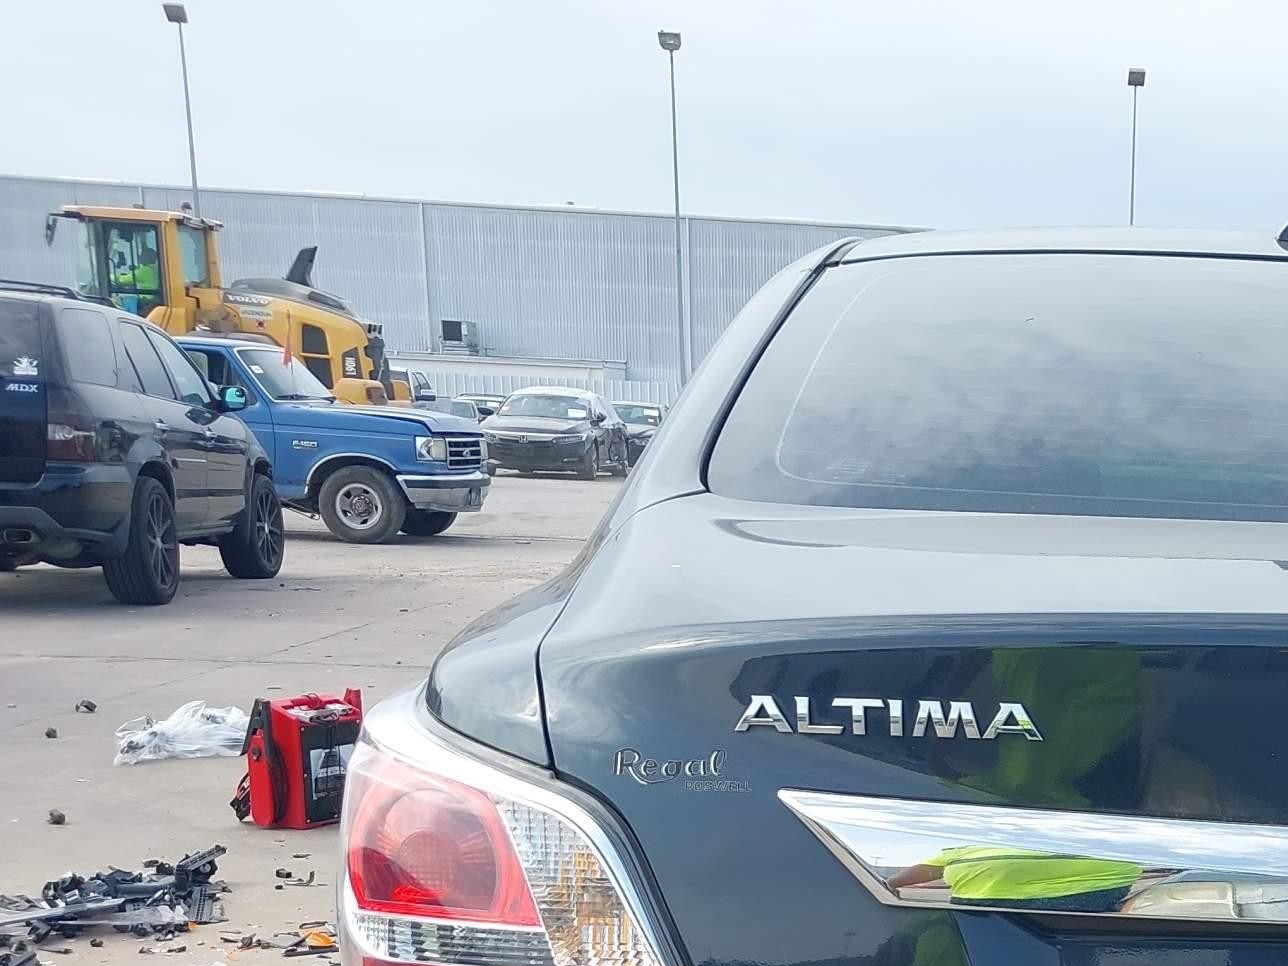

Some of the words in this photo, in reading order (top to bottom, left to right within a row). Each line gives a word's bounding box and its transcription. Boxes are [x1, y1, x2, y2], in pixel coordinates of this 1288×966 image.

[226, 294, 269, 305] VOLVO
[6, 383, 38, 392] MDX
[734, 694, 1044, 742] ALTIMA
[613, 748, 727, 785] Regal
